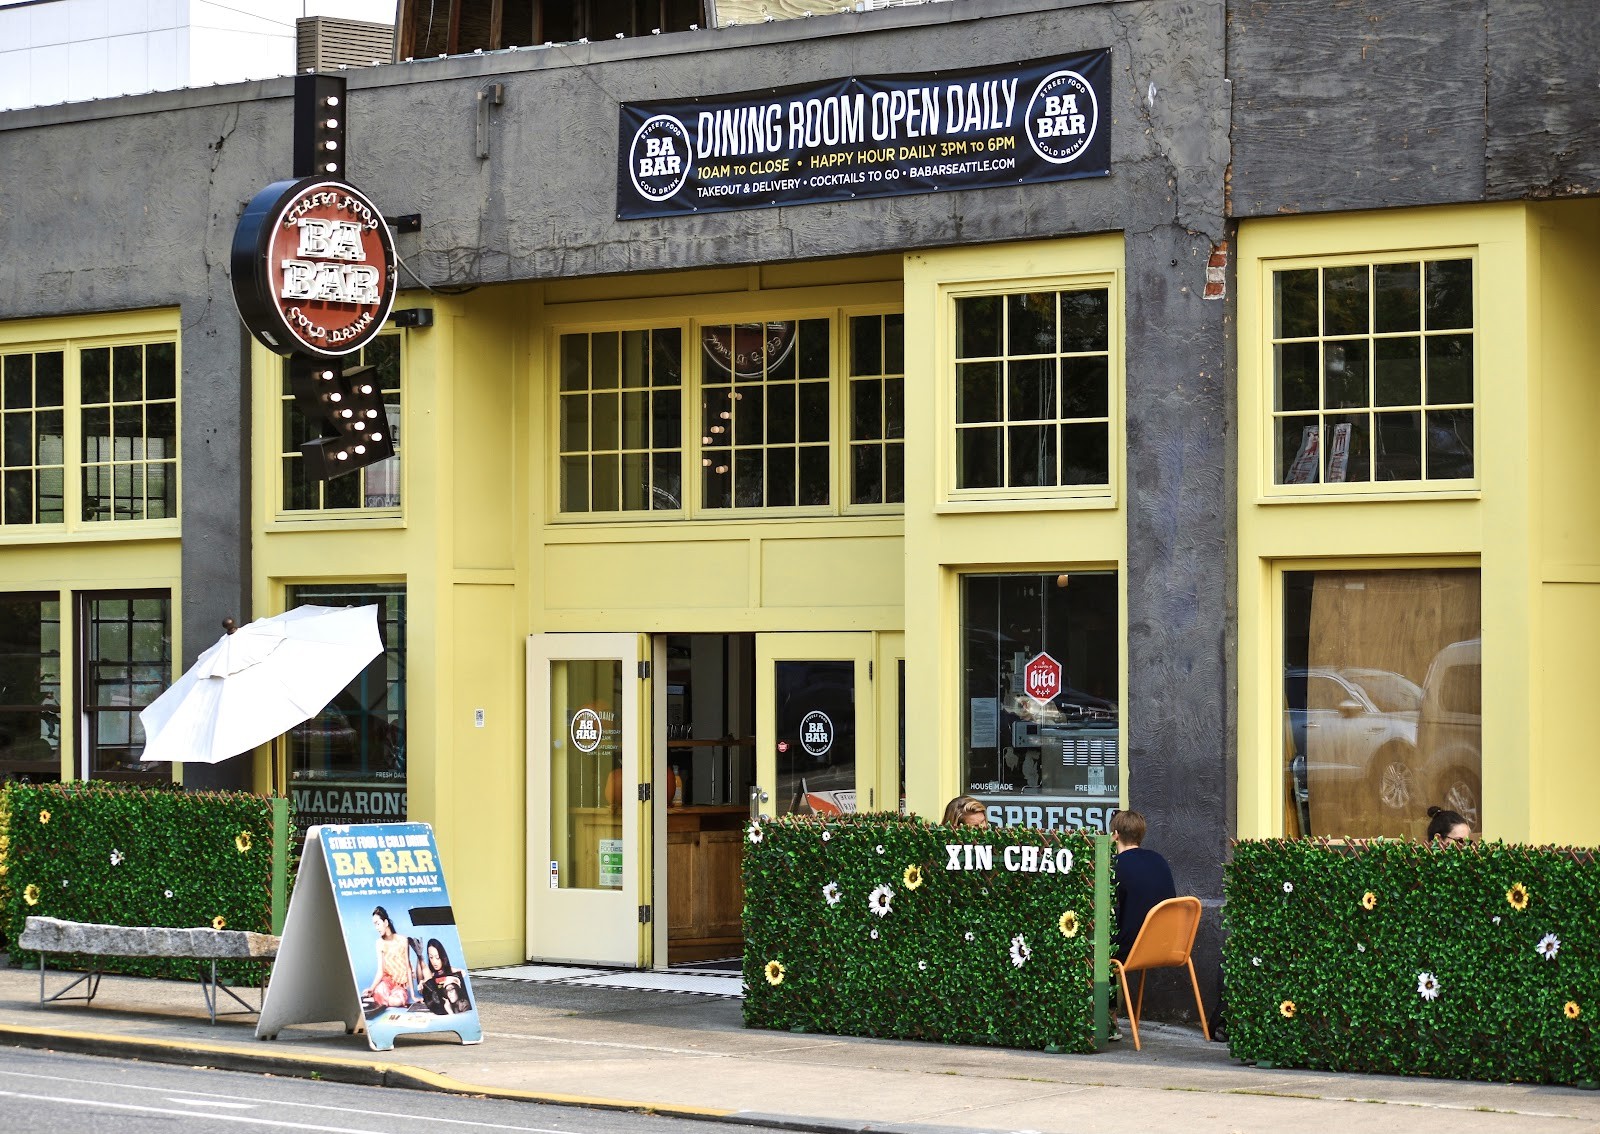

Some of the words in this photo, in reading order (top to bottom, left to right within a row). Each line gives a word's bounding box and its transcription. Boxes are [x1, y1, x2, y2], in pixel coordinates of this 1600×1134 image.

[1040, 78, 1065, 99] STREET
[1067, 78, 1085, 94] FOOD
[1045, 94, 1078, 117] BA
[641, 121, 664, 139] STREET
[665, 122, 682, 137] FOOD
[697, 103, 782, 159] DINING
[788, 93, 865, 150] ROOM
[871, 86, 940, 141] OPEN
[946, 78, 1018, 134] DAILY
[1037, 114, 1086, 139] BAR
[646, 136, 675, 157] BA
[697, 164, 731, 180] 10AM
[749, 158, 790, 175] CLOSE
[810, 151, 854, 169] HAPPY
[857, 148, 896, 164] HOUR
[899, 143, 937, 160] DAILY
[940, 141, 967, 157] 3PM
[987, 135, 1015, 152] 6PM
[1038, 141, 1058, 157] COLD
[1060, 138, 1084, 157] DRINK
[638, 155, 681, 178] BAR
[697, 184, 742, 198] TAKEOUT
[743, 183, 751, 193] &
[752, 178, 801, 193] DELIVERY
[810, 173, 866, 188] COCKTAILS
[867, 170, 882, 182] TO
[884, 168, 900, 180] GO
[909, 158, 1015, 178] BABARSEATTLE.COM
[640, 180, 657, 194] COLD
[658, 178, 680, 194] DRINK
[288, 192, 337, 226] STREET
[339, 195, 379, 230] FOOD
[297, 217, 367, 261] BA
[281, 259, 381, 305] BAR
[290, 306, 325, 338] COLD
[332, 311, 375, 342] DRINK
[805, 732, 828, 743] BAR
[808, 722, 824, 732] BA
[970, 782, 993, 790] HOUSE
[993, 783, 1014, 791] MADE
[328, 836, 357, 850] STREET
[357, 835, 378, 849] FOOD
[385, 835, 406, 848] COLD
[331, 851, 375, 876] BA
[376, 849, 437, 874] BAR
[945, 844, 993, 871] XIN
[338, 877, 374, 889] HAPPY
[376, 876, 408, 887] HOUR
[408, 874, 438, 886] DAILY
